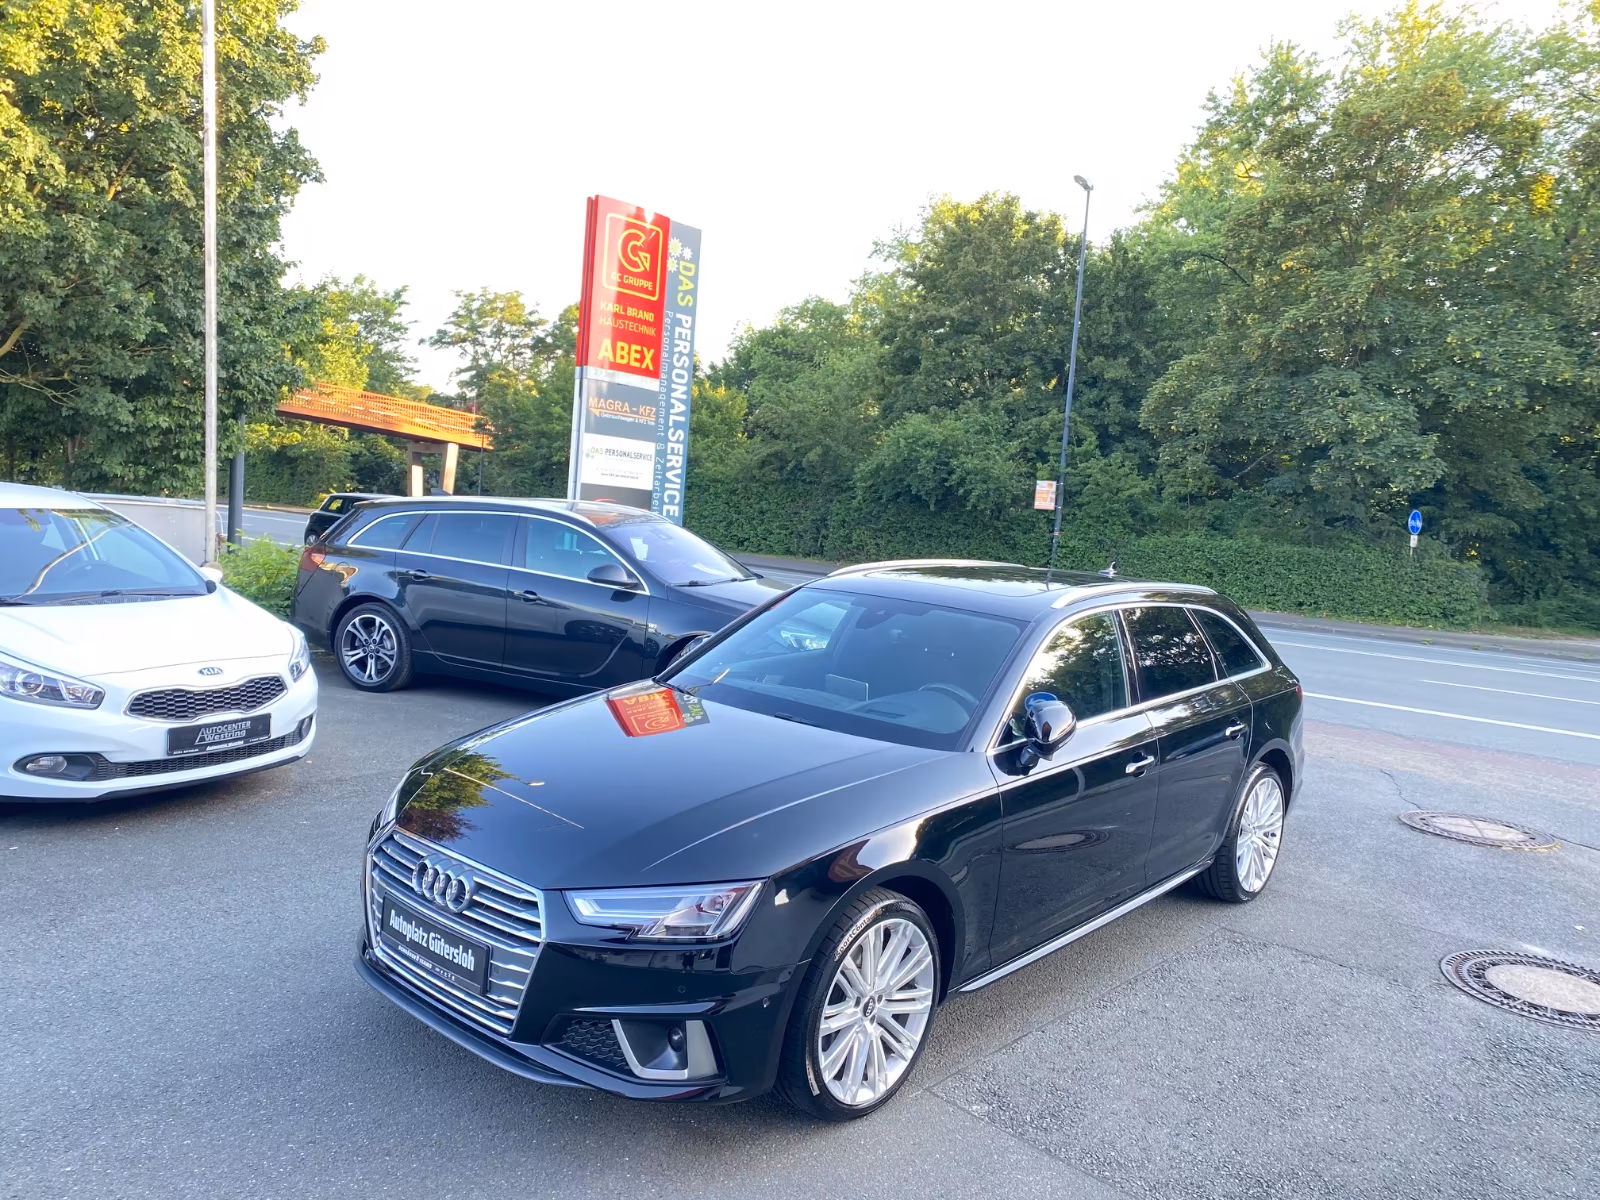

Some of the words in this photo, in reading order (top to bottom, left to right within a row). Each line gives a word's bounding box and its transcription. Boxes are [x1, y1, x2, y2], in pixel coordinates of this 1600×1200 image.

[623, 274, 653, 291] GRUPPE
[677, 260, 696, 307] DAS
[600, 302, 625, 315] KARL
[627, 305, 655, 322] BRAND
[599, 317, 657, 337] HAUSTECHNIK
[597, 338, 655, 371] ABEX
[657, 310, 674, 436] Personalmanagement
[588, 396, 630, 413] MAGRA
[639, 404, 656, 418] KFZ
[662, 313, 692, 517] PERSONALSERVICE
[605, 448, 653, 462] PERSONALSERVICE
[201, 667, 222, 676] KIA
[205, 729, 246, 742] Westring
[389, 909, 428, 948] Autoplatz
[429, 931, 475, 972] Gütersloh
